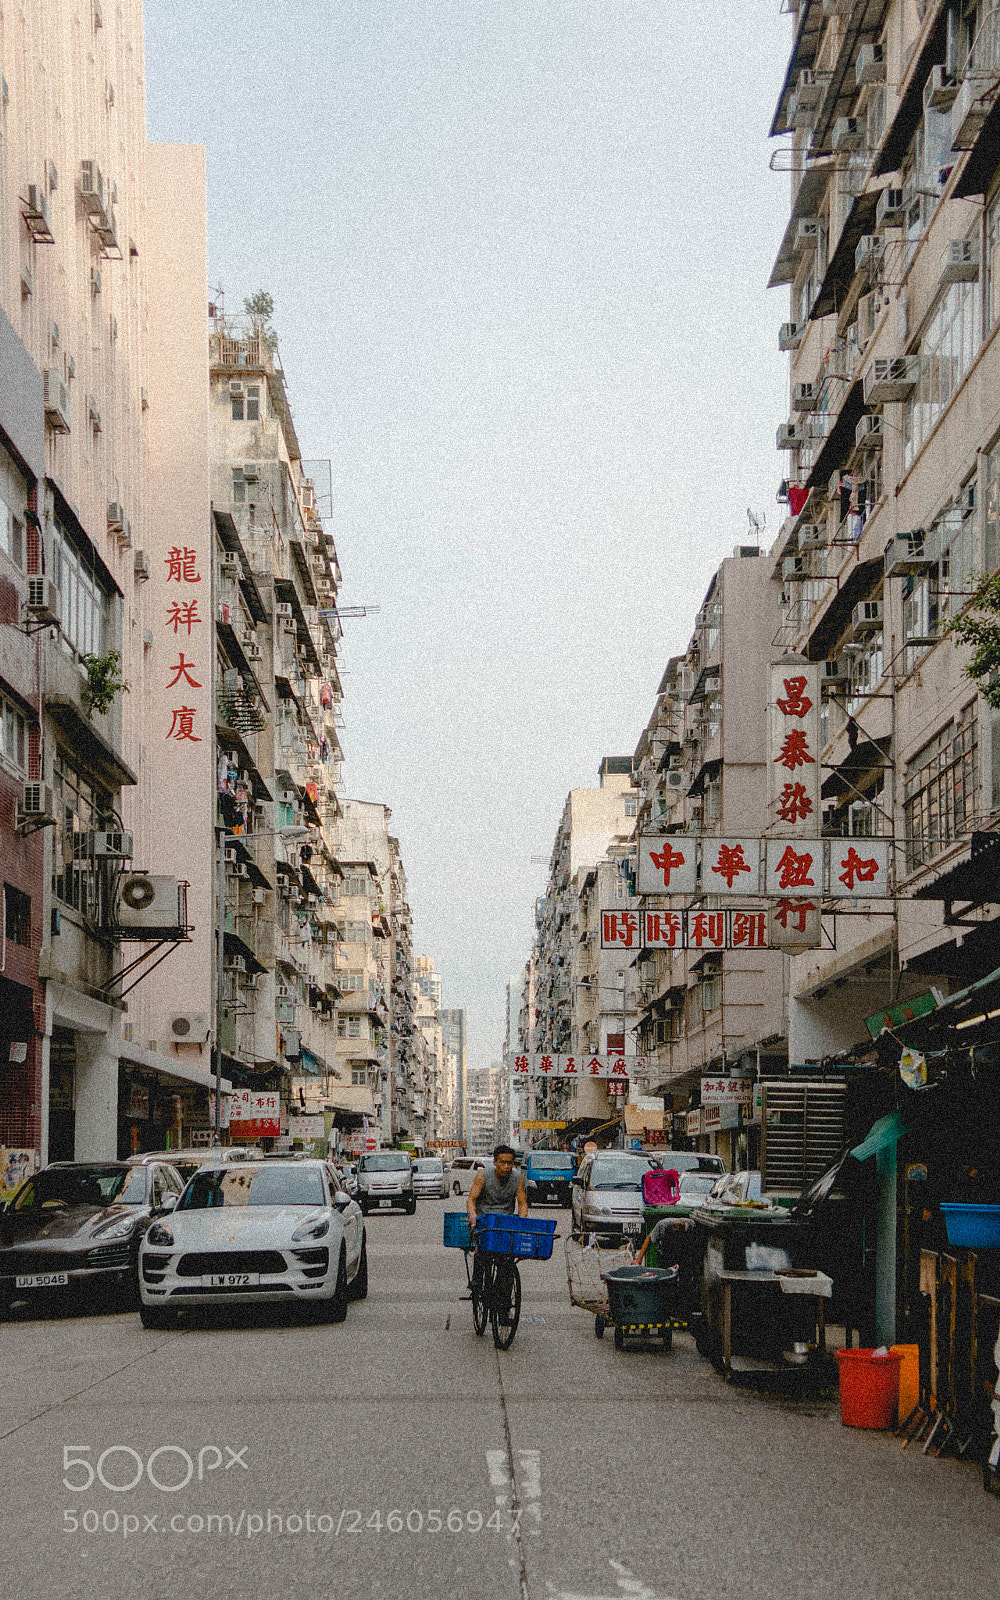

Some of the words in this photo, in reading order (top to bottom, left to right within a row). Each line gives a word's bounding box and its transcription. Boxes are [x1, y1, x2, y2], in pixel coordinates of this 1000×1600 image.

[164, 546, 202, 742] 龍祥大廈
[774, 676, 816, 932] 昌泰染行
[649, 842, 880, 890] 中華鈕扣
[36, 1275, 65, 1285] 5046
[228, 1274, 249, 1285] 972
